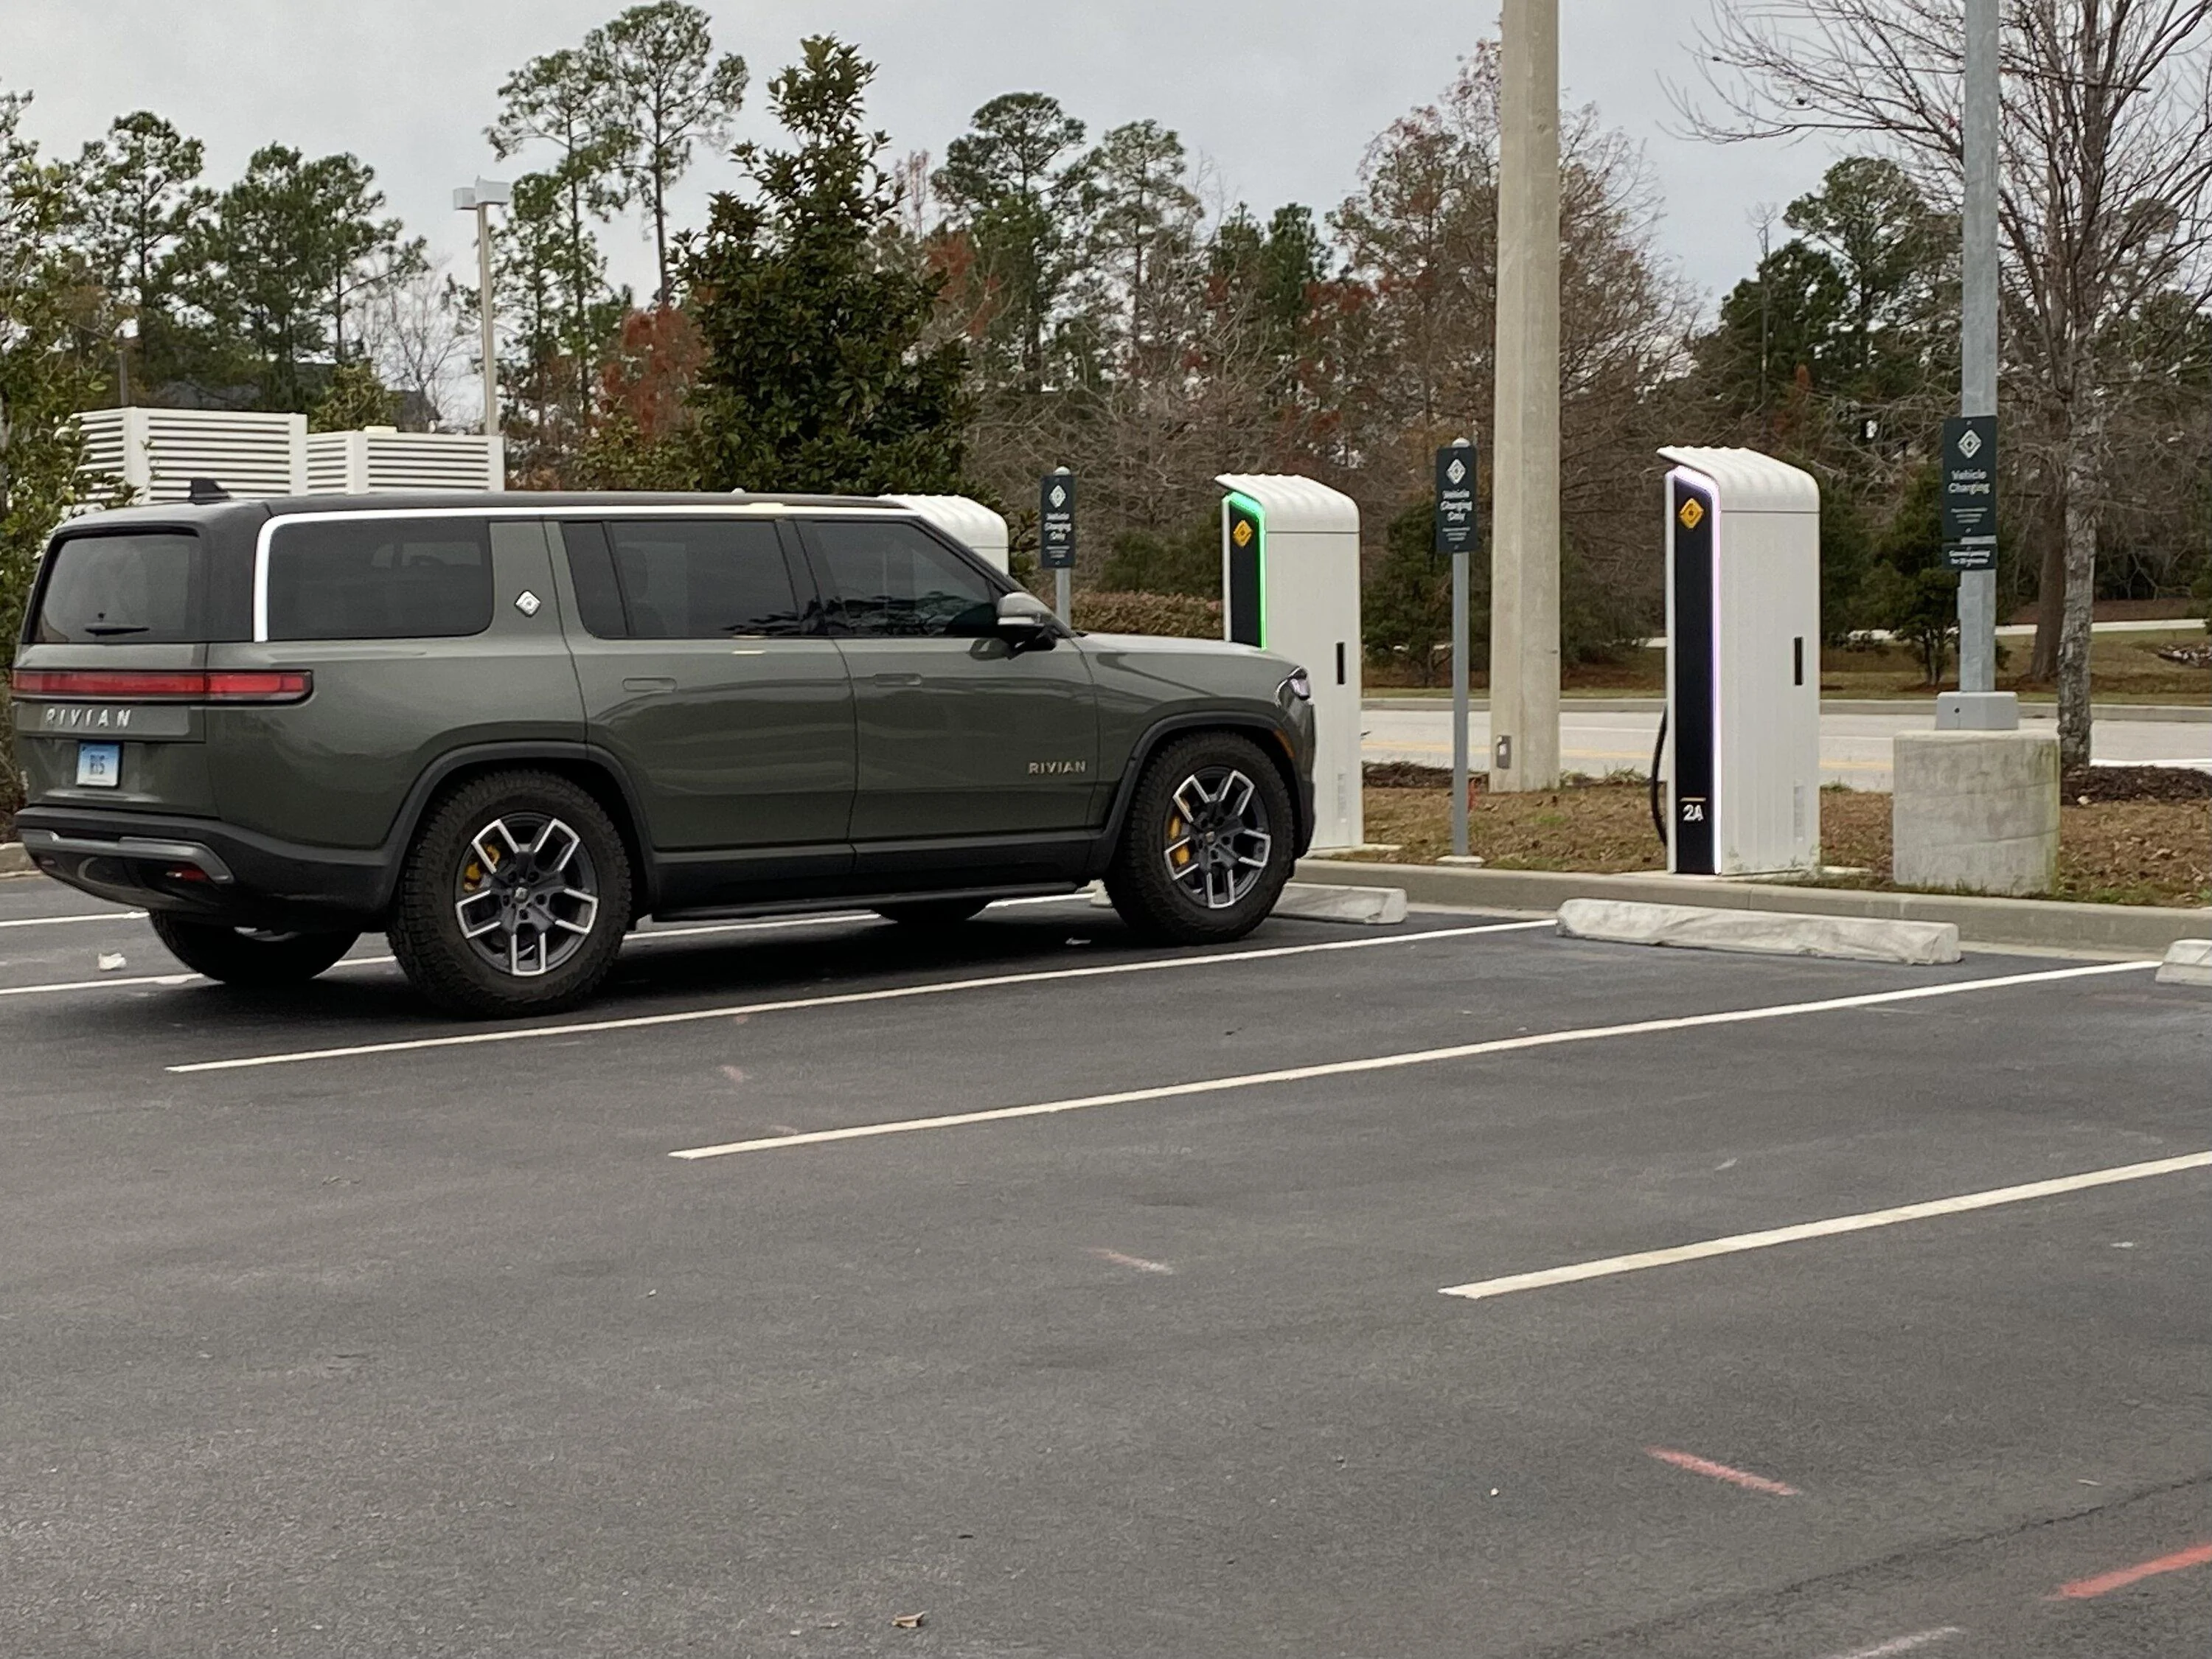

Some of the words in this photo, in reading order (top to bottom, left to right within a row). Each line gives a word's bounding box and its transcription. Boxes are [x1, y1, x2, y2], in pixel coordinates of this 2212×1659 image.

[1951, 468, 1987, 481] Vehicle
[1948, 483, 1990, 495] Charging
[46, 708, 131, 727] RIVIAN
[1029, 760, 1086, 774] RIVIAN
[1683, 804, 1704, 821] 2A
